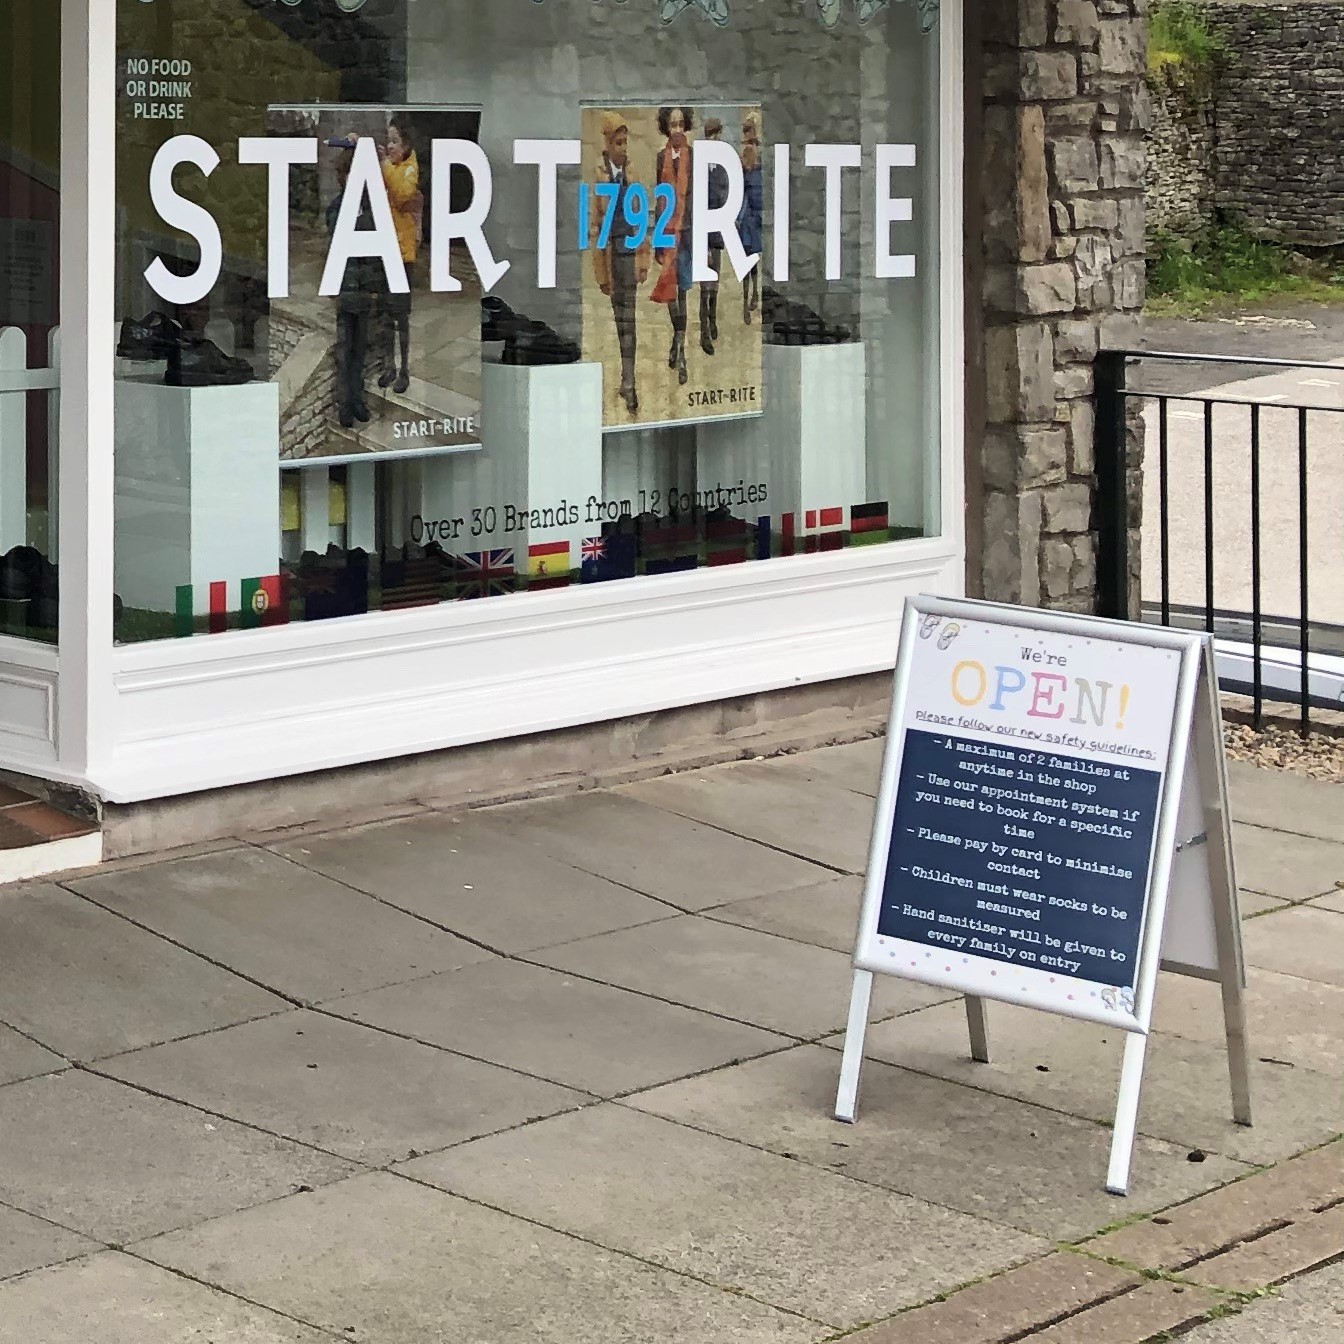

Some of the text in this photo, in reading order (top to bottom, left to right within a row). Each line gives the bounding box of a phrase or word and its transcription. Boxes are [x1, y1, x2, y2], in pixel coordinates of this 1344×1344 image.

[127, 59, 191, 75] NO FOOD
[127, 81, 192, 97] OR DRINK
[134, 103, 184, 119] PLEASE
[144, 134, 581, 305] START
[578, 182, 676, 250] 1792
[692, 139, 917, 283] RITE
[410, 480, 768, 544] Over 30 Brands from 12 Countries
[1021, 646, 1067, 667] We're
[951, 660, 1130, 730] OPEN!
[958, 716, 994, 732] follow
[997, 724, 1016, 736] our
[1020, 728, 1043, 740] new
[1046, 732, 1086, 750] safety
[945, 739, 1130, 781] A maximum of 2 families at
[959, 760, 1097, 794] anytime in the shop
[915, 790, 1132, 839] you need to book for a specific
[928, 773, 1140, 823] Use our appointment system if
[1003, 824, 1035, 839] time
[918, 827, 1133, 880] Please pay by card to minimise
[987, 859, 1041, 880] contact
[912, 865, 1128, 921] Children must wear socks to be
[977, 899, 1041, 921] measured
[903, 904, 1126, 962] Hand sanitiser will be given to
[927, 929, 1081, 973] every family on entry
